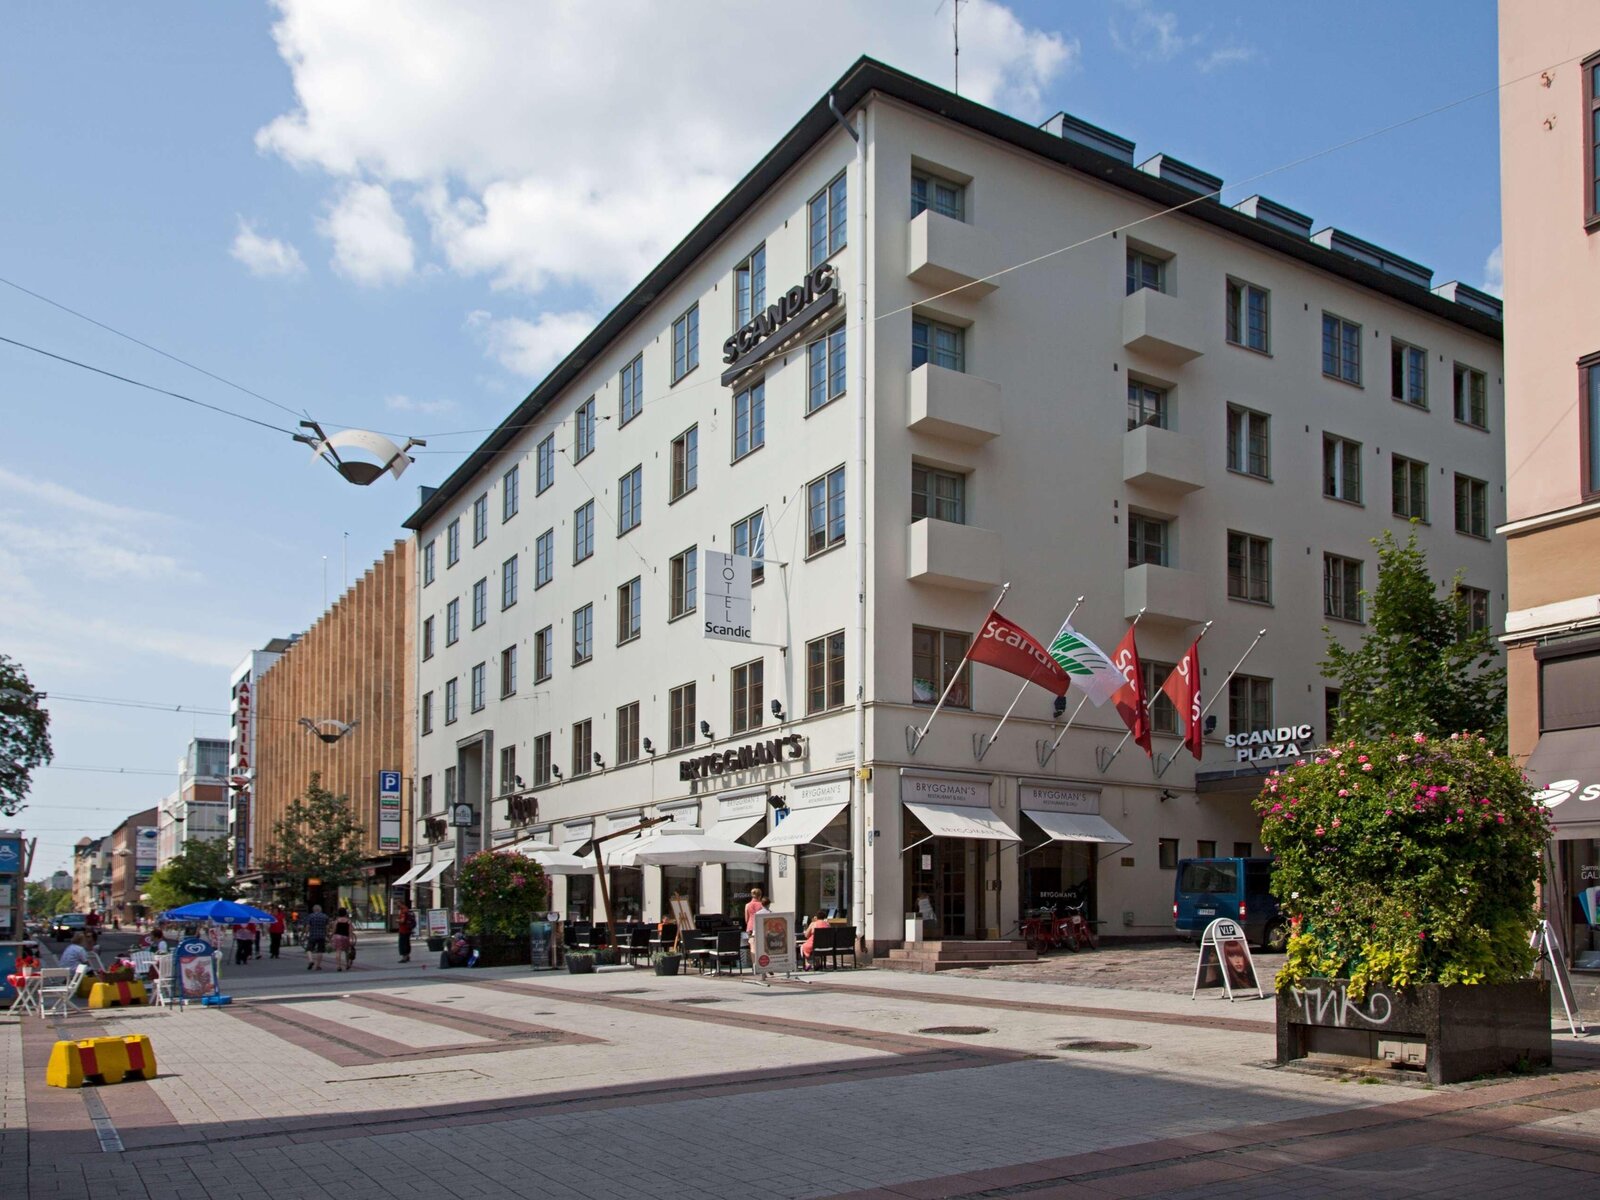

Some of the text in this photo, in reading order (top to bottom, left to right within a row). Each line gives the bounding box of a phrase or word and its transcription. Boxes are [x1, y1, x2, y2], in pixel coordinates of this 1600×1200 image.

[722, 263, 834, 365] SCANDIC
[722, 553, 735, 623] HOTEL
[705, 621, 751, 639] Scandic
[239, 683, 250, 769] ANTTILA
[1224, 724, 1312, 748] SCANDIC
[679, 733, 803, 782] BRYGGMAN'S
[1236, 743, 1301, 762] PLAZA
[385, 777, 396, 790] P
[801, 785, 841, 799] BRYGGMAN'S
[916, 782, 976, 796] BRYGGMAN'S
[1033, 789, 1087, 802] BRYGGMAN'S
[1581, 871, 1600, 880] GAL
